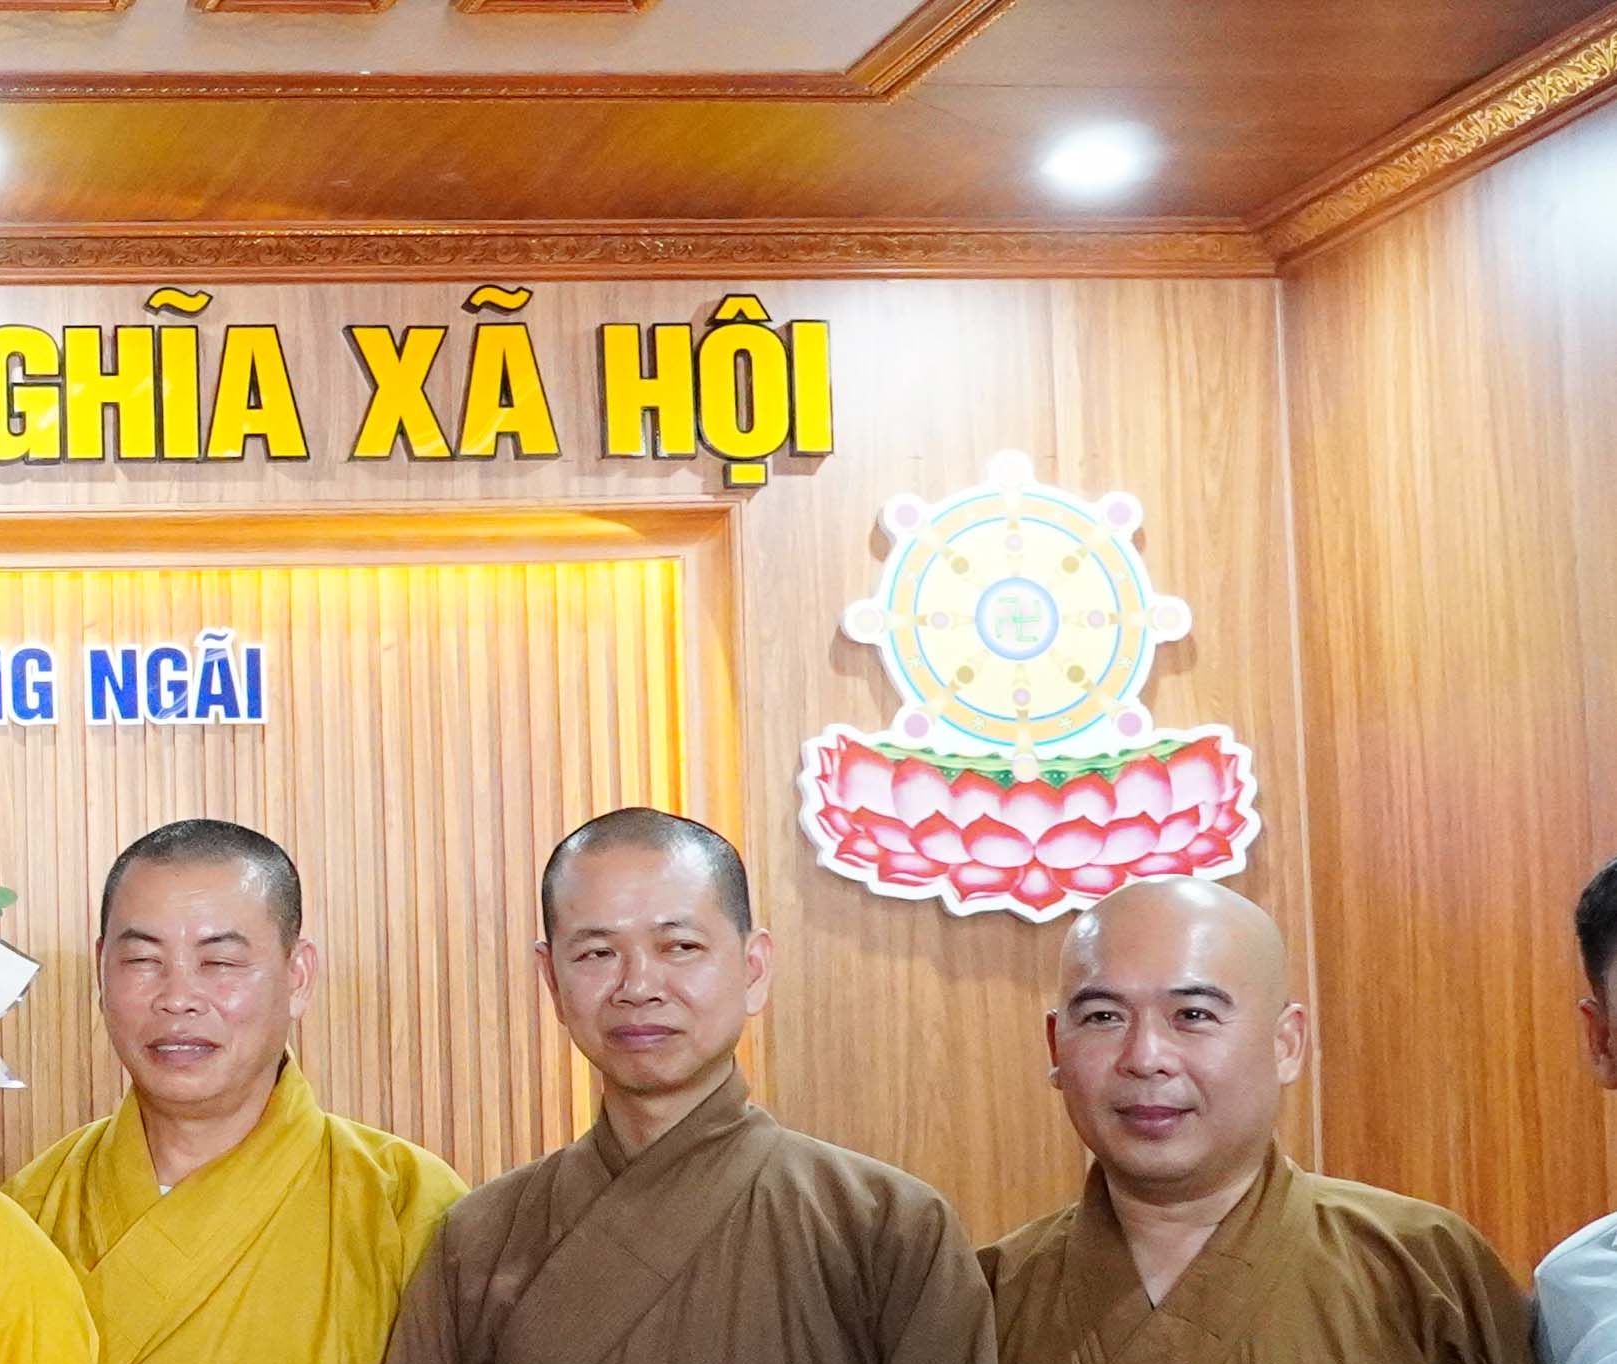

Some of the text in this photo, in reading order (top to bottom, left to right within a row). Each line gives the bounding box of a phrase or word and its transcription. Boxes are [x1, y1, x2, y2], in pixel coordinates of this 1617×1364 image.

[347, 284, 562, 461] XÃ
[597, 294, 835, 488] HỘI
[88, 630, 264, 720] NGÃI
